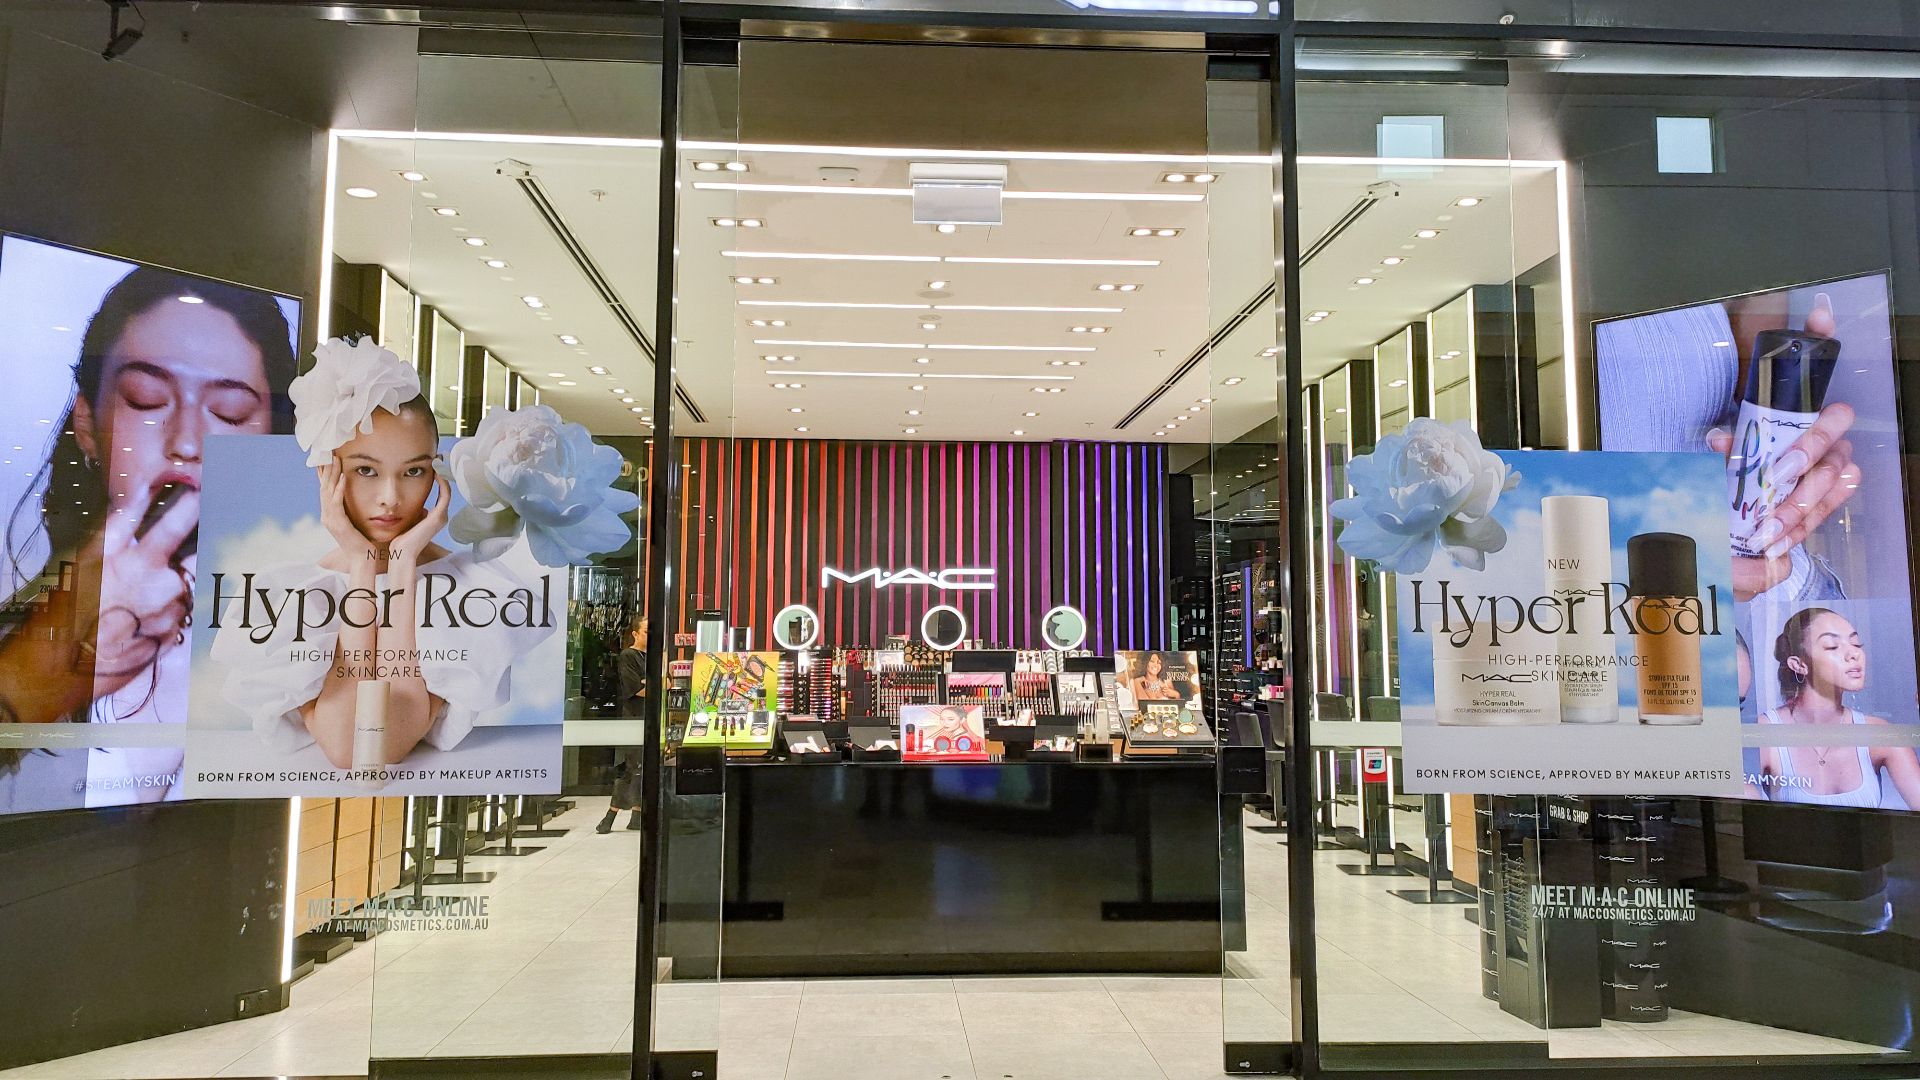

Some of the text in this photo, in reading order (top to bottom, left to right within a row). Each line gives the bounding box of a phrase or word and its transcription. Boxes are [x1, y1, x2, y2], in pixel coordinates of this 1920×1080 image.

[366, 549, 403, 561] NEW
[1548, 559, 1580, 570] NEW
[208, 573, 552, 644] Hyper Real
[1411, 580, 1722, 648] Hyper Real
[290, 649, 468, 662] HIGH-PERFORMANCE
[1488, 654, 1648, 667] HIGH-PERFORMANCE
[336, 665, 422, 678] SKINCARE
[1531, 670, 1608, 682] SKINCARE
[198, 769, 548, 782] BORN FROM SCIENCE, APPROVED BY MAKEUP ARTISTS
[1416, 769, 1731, 780] BORN FROM SCIENCE, APPROVED BY MAKEUP ARTISTS
[1743, 773, 1812, 788] EAMYSKIN
[74, 773, 177, 792] #STEAMYSKIN
[1549, 804, 1589, 825] GRAB & SHOP
[1531, 885, 1577, 907] MEET
[1634, 887, 1696, 909] ONLINE
[422, 896, 490, 917] ONLINE
[1532, 905, 1696, 922] 24/7 AT MACCOSMETICS.COM.AU
[335, 919, 350, 933] AT
